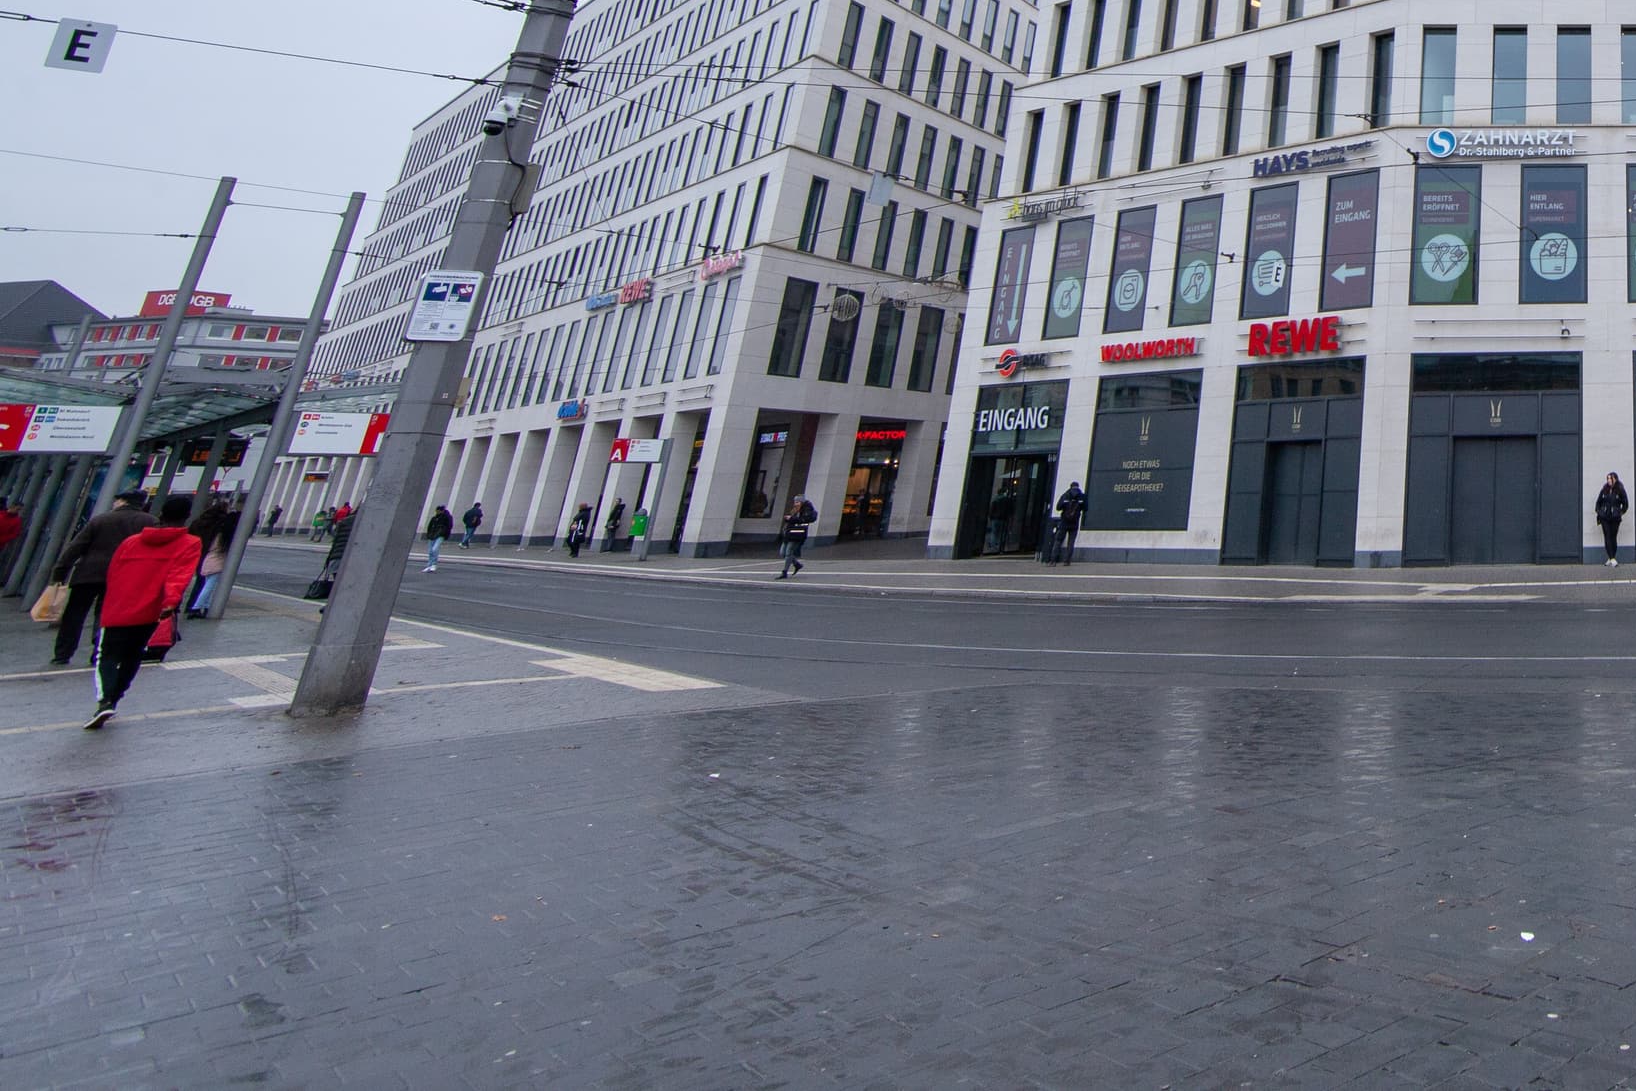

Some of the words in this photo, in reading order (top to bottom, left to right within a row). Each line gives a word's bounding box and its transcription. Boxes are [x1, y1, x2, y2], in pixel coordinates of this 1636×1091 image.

[64, 28, 98, 63] E
[1459, 129, 1577, 146] ZAHNARZT
[1459, 146, 1473, 156] Dr.
[1476, 146, 1525, 158] Stahlberg
[1528, 147, 1535, 156] &
[1538, 146, 1576, 156] Partner
[1253, 150, 1309, 178] HAYS
[1335, 200, 1354, 211] ZUM
[1423, 194, 1453, 202] BEREITS
[1423, 202, 1460, 211] ERÖFFNET
[1529, 202, 1565, 210] ENTLANG
[1335, 210, 1371, 224] EINGANG
[994, 247, 1014, 339] EINGANG
[1248, 316, 1341, 357] REWE
[1100, 337, 1197, 362] WOOLWORTH
[978, 405, 1050, 432] EINGANG
[610, 448, 622, 461] A
